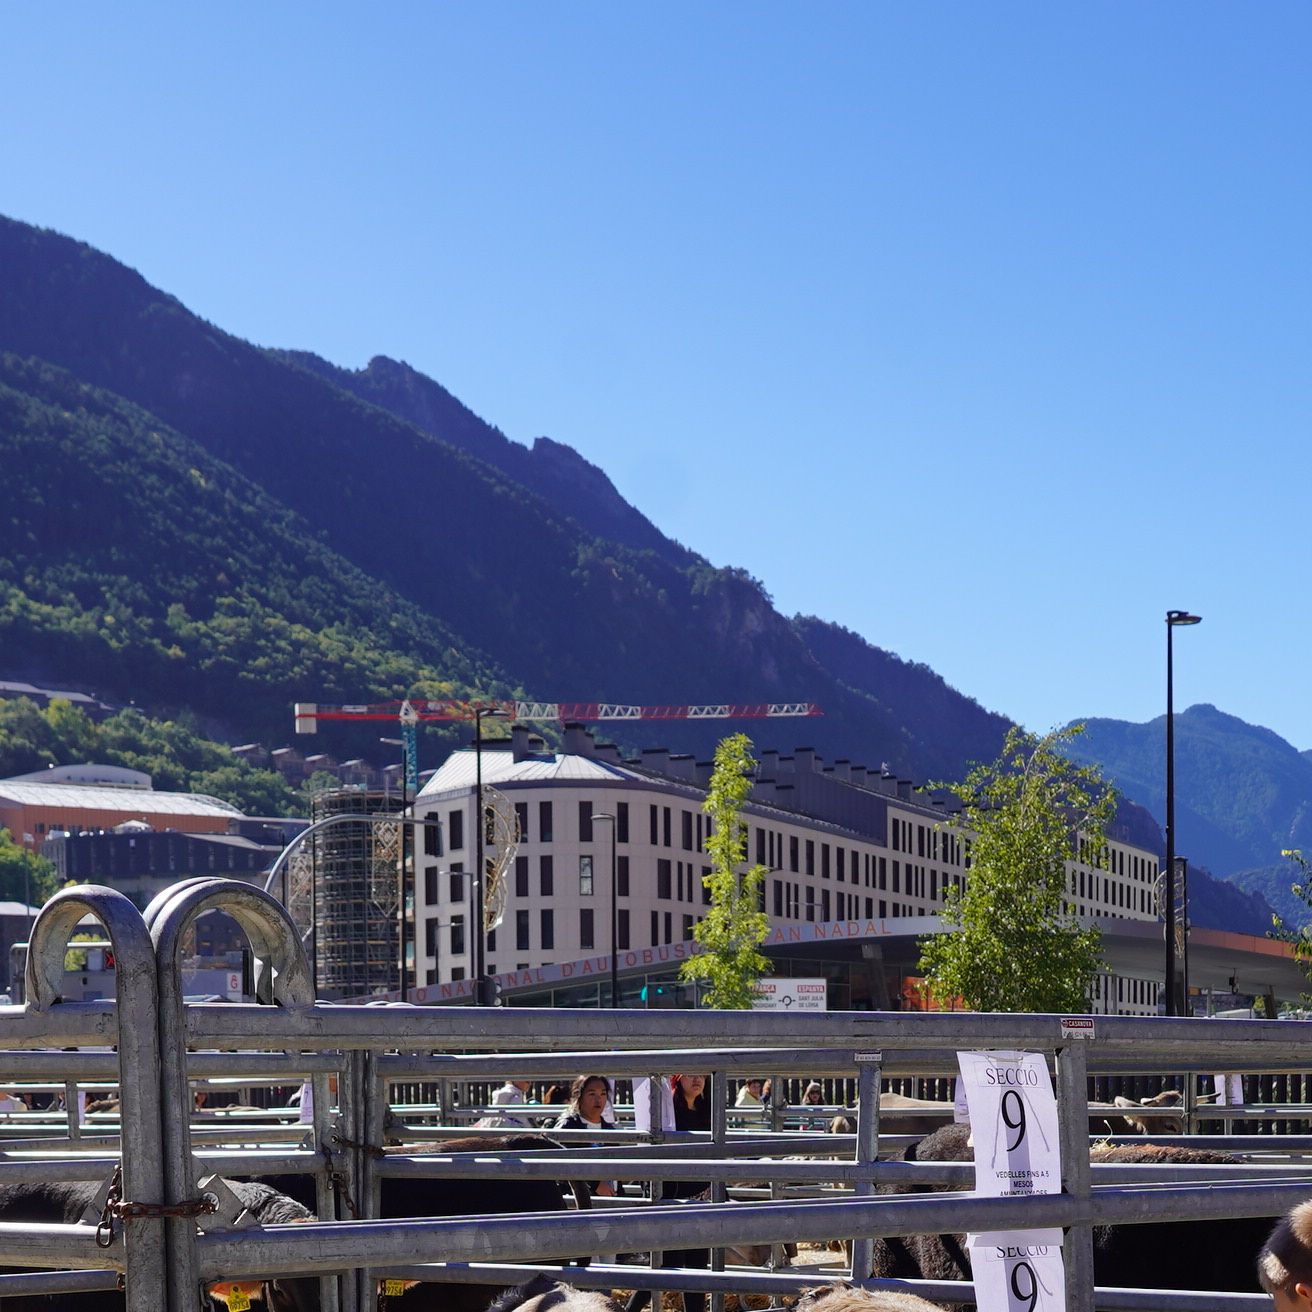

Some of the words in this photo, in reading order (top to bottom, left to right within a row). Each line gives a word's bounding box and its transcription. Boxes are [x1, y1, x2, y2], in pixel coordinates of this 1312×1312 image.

[814, 920, 893, 939] NADAL
[798, 985, 824, 993] ESPANYA
[985, 1064, 1038, 1086] SECCIÓ
[1001, 1089, 1026, 1152] 9
[996, 1170, 1026, 1178] VEDELLES
[1026, 1170, 1039, 1178] FINS
[1013, 1180, 1033, 1188] MESOS
